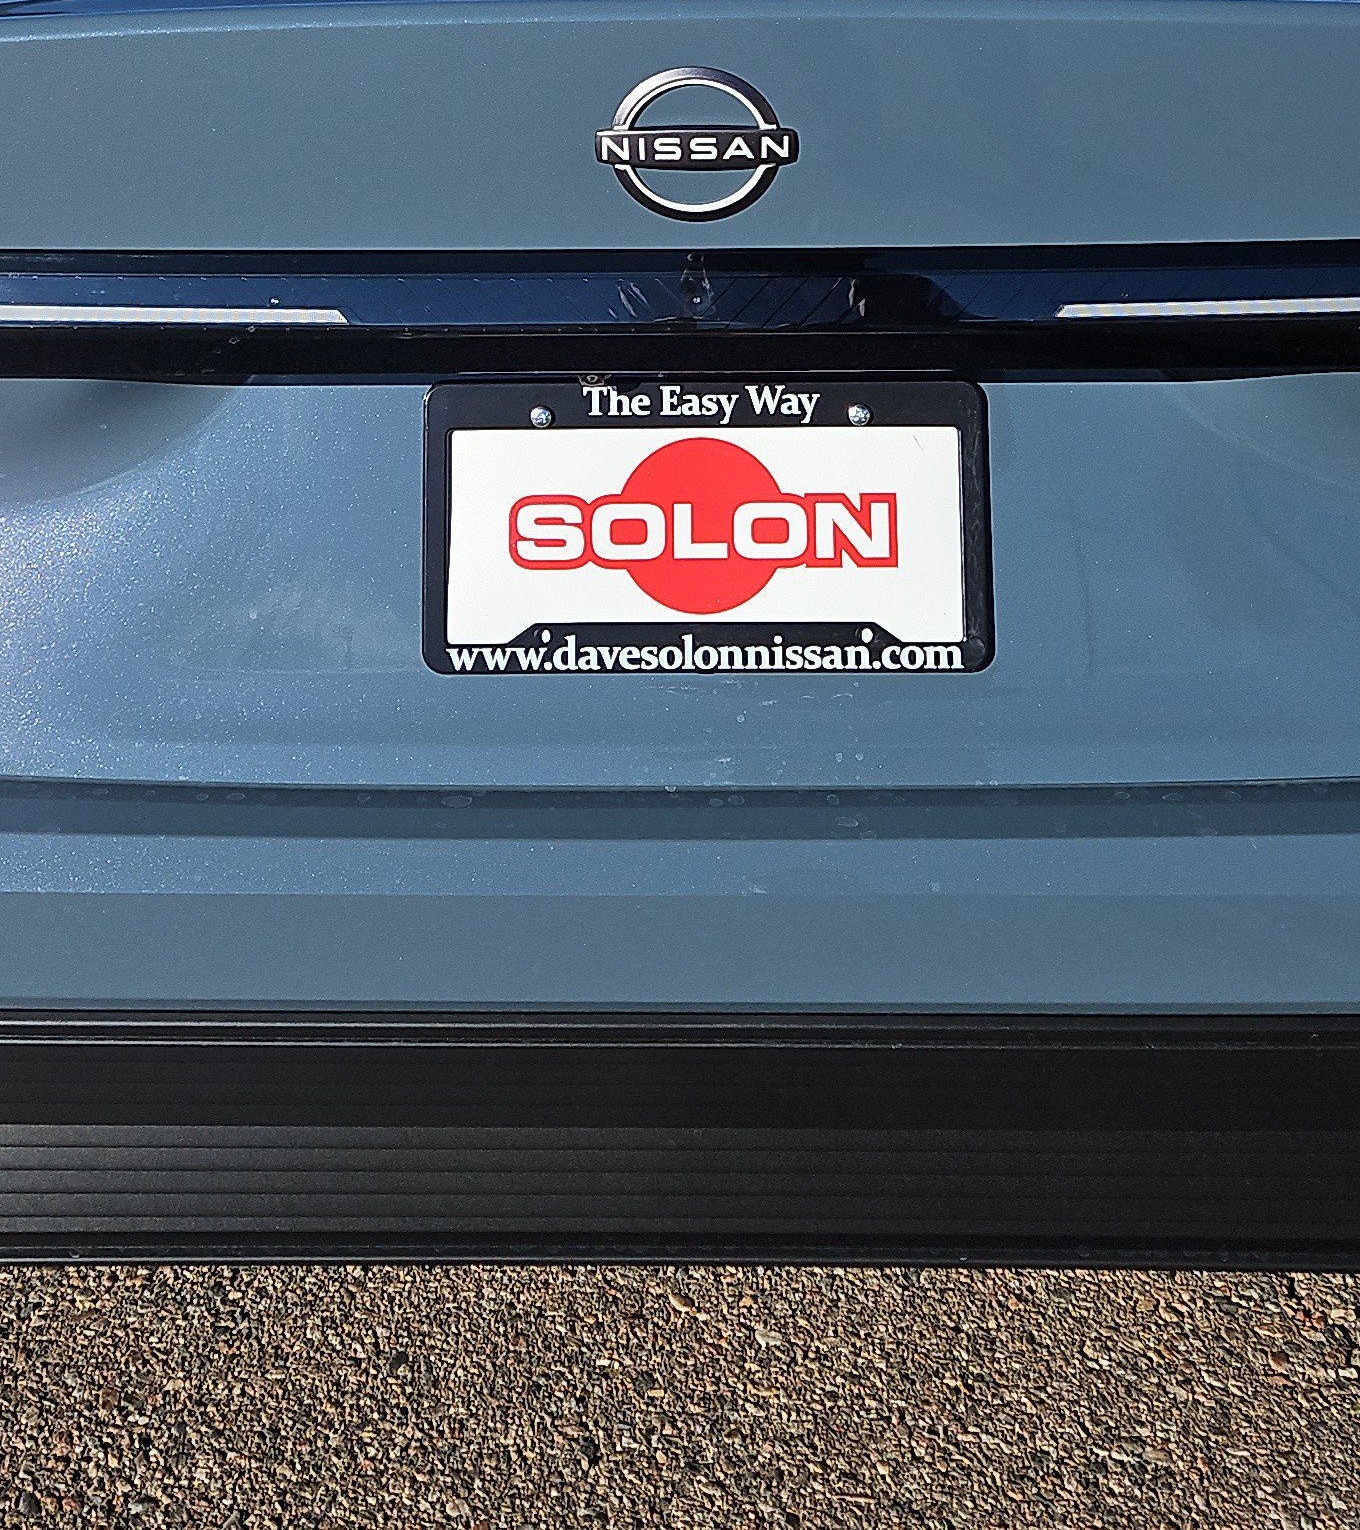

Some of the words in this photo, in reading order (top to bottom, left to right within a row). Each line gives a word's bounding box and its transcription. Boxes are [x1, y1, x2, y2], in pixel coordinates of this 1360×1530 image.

[600, 134, 791, 161] NISSAN
[583, 385, 652, 418] The
[659, 387, 740, 426] Easy
[744, 386, 821, 426] Way
[509, 493, 898, 570] SOLON
[446, 634, 965, 672] www.davesolonnissan.com
